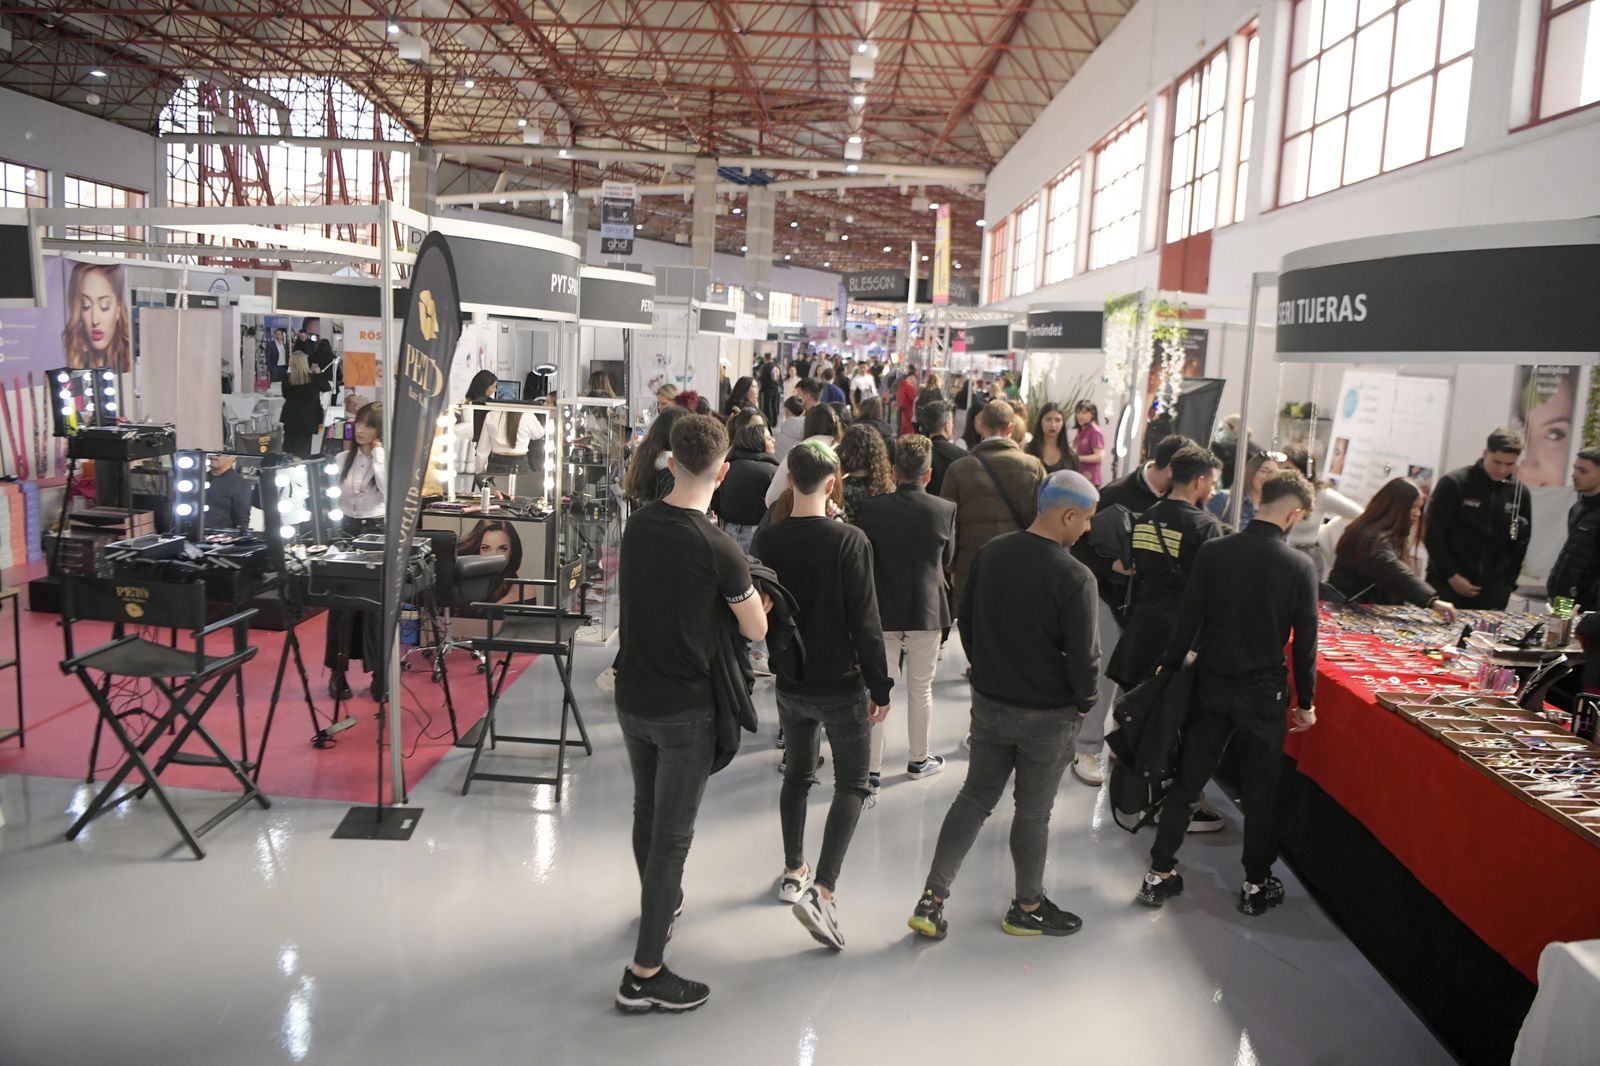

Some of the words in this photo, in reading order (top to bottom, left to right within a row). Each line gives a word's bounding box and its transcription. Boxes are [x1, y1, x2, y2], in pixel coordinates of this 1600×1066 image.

[607, 238, 628, 251] ghd
[551, 273, 568, 294] PYT
[849, 276, 895, 292] BLESSON
[1297, 292, 1367, 324] TIJERAS
